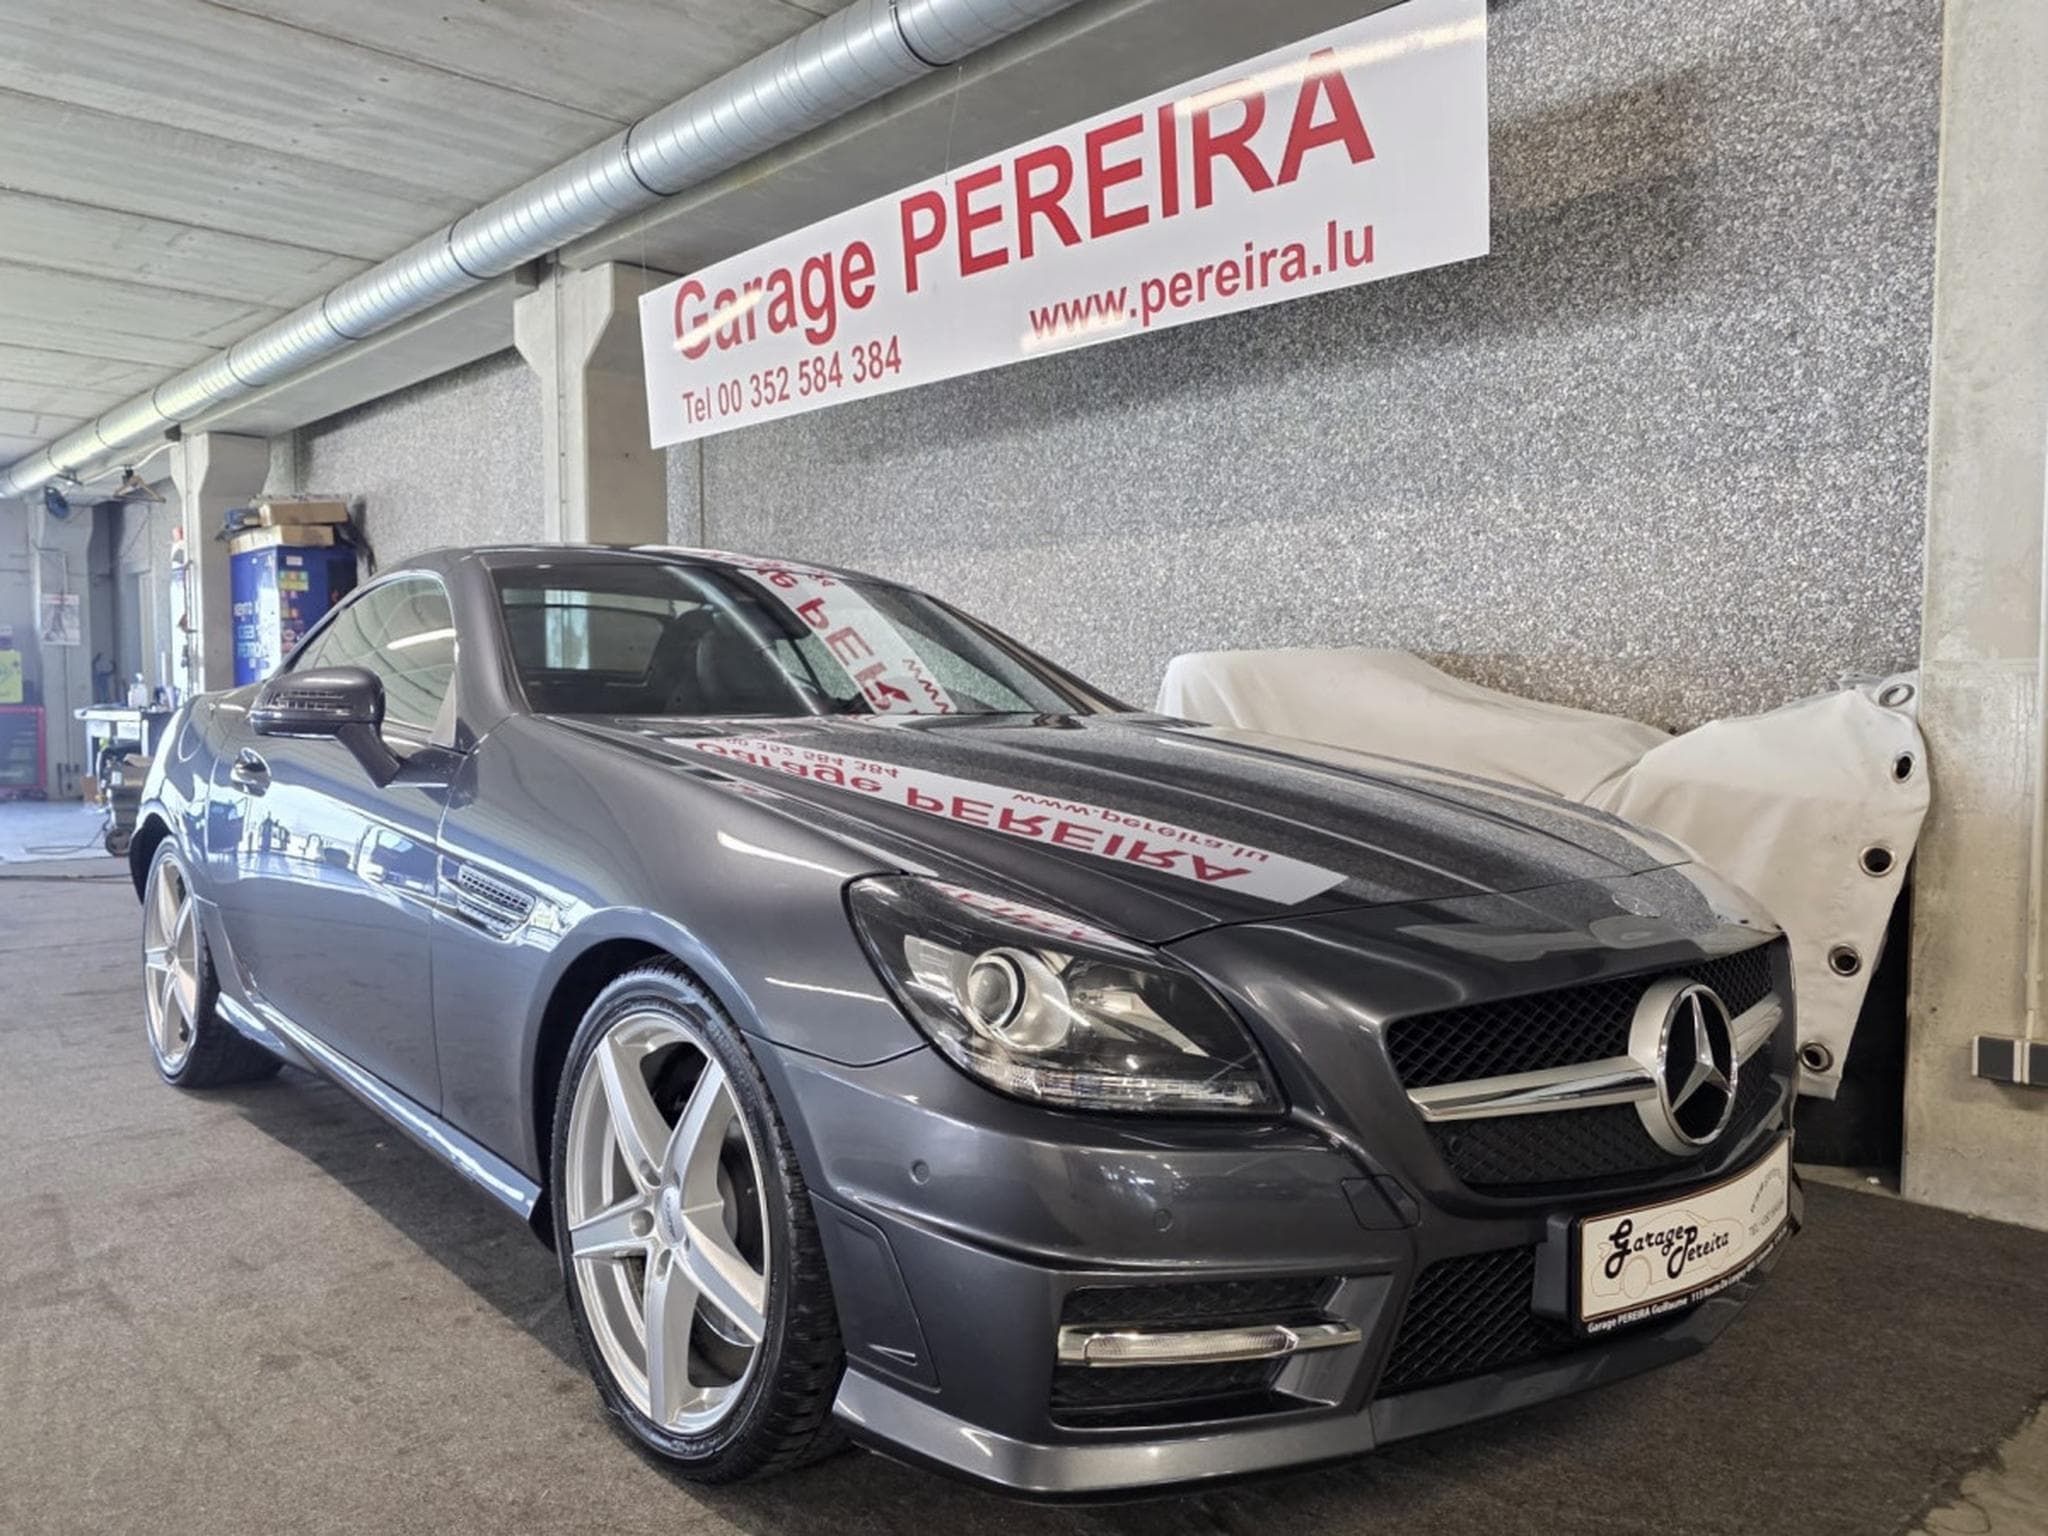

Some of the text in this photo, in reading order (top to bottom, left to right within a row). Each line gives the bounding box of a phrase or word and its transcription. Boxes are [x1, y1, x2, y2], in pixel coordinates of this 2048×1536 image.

[674, 46, 1376, 361] Garage PEREIRA
[1029, 219, 1375, 340] www.pereira.lu
[682, 334, 902, 425] Tel 00 352 584 384
[1604, 1218, 1684, 1279] Garage
[1667, 1225, 1729, 1279] Pereira
